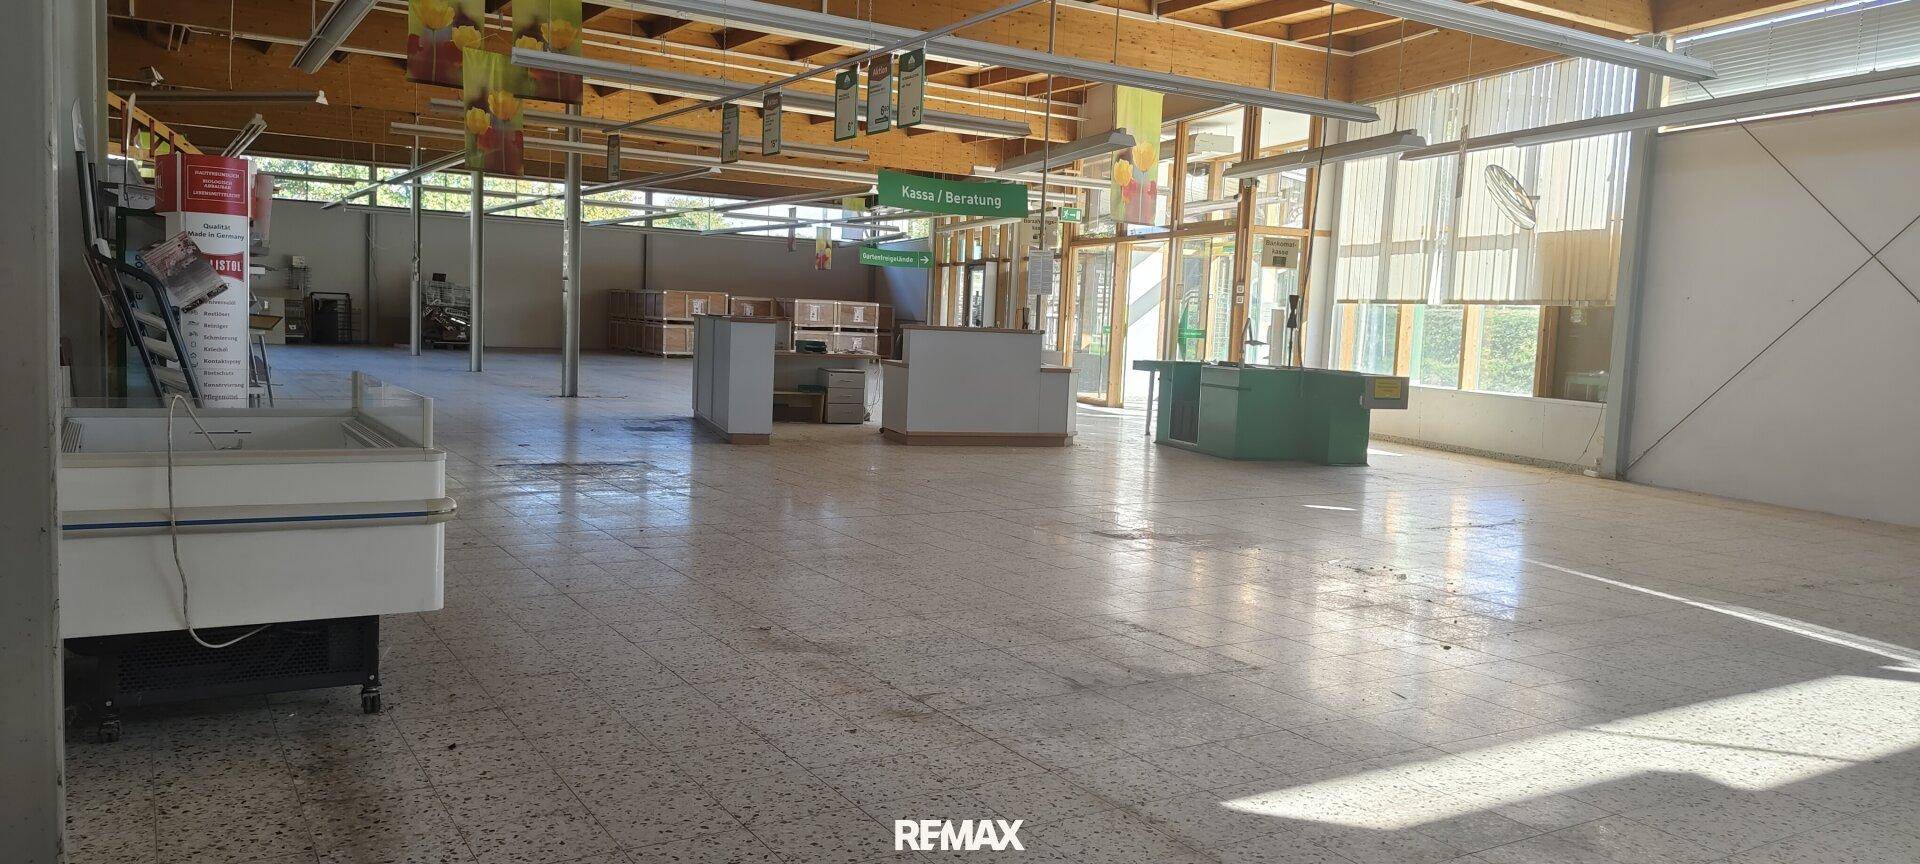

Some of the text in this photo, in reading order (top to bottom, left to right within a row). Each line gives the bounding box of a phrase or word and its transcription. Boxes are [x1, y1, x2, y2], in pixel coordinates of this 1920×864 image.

[902, 185, 1002, 209] Kassa / Beratung
[203, 223, 232, 231] Qualität
[216, 232, 245, 242] Germany
